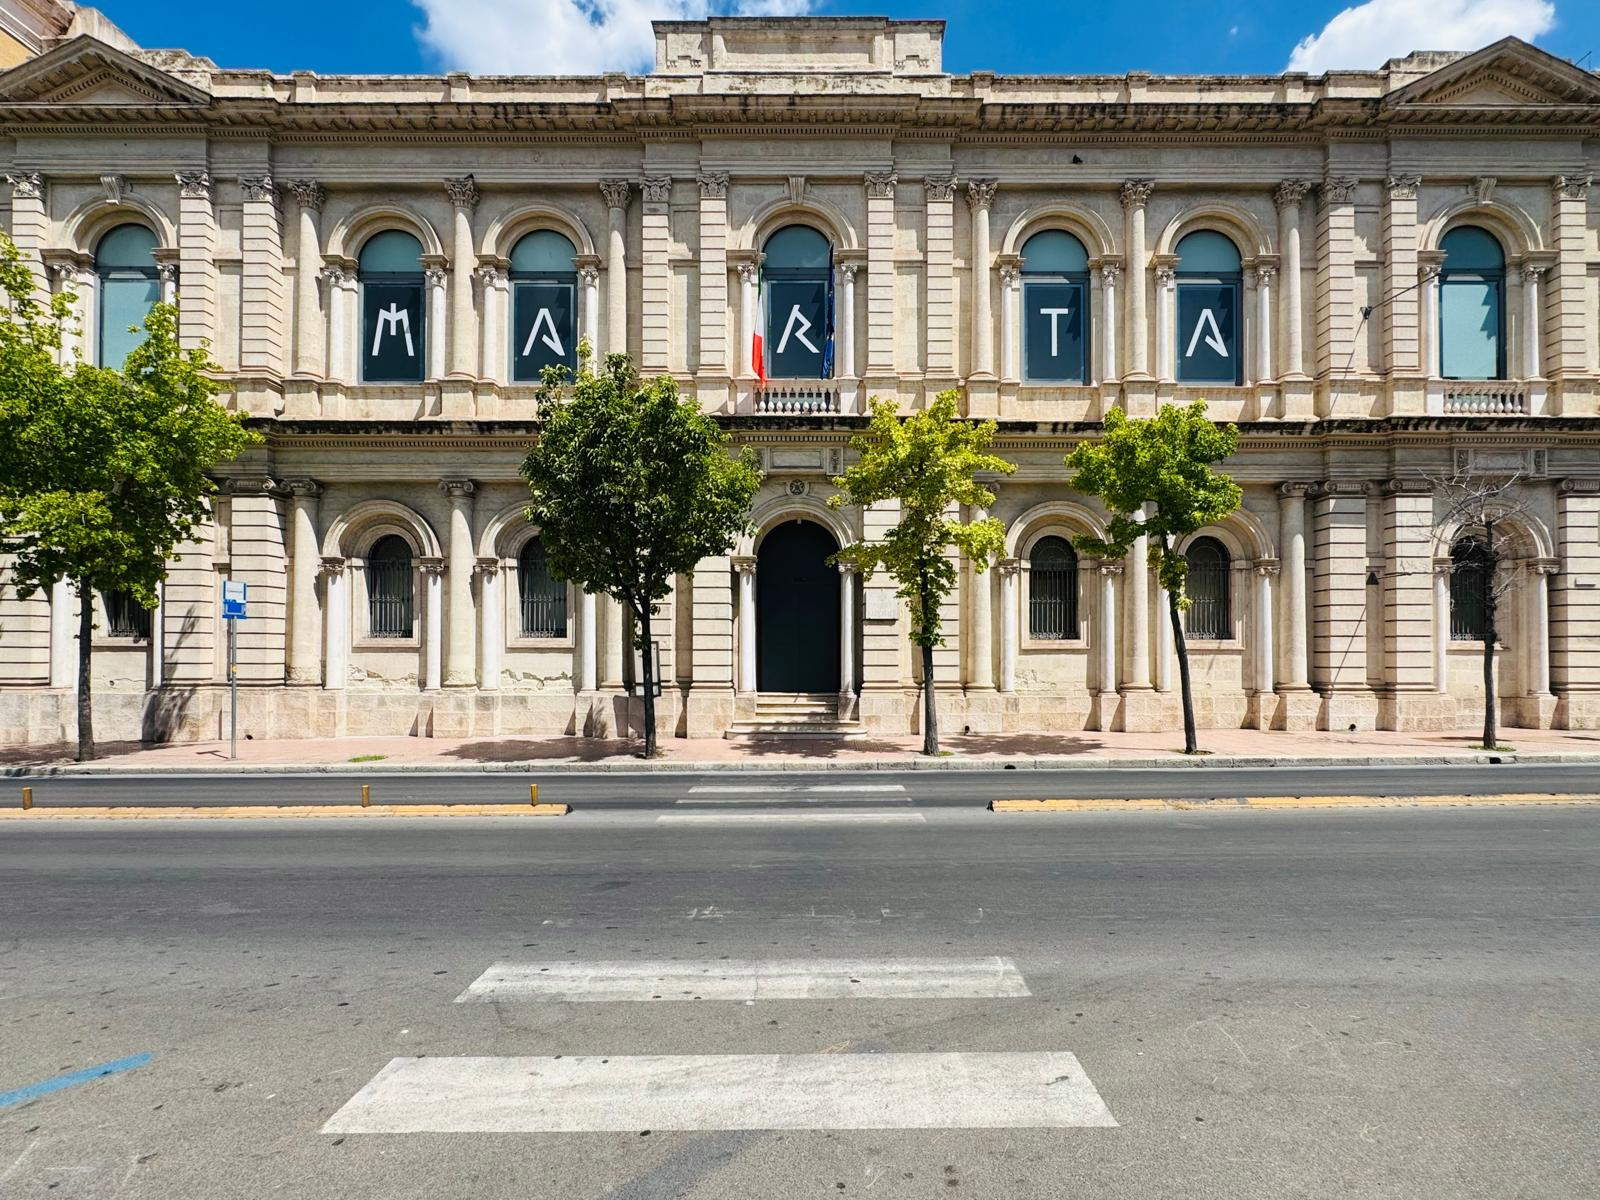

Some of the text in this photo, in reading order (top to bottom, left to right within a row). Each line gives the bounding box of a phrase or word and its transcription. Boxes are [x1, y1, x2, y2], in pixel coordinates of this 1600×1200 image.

[371, 302, 1229, 357] M A R T A
